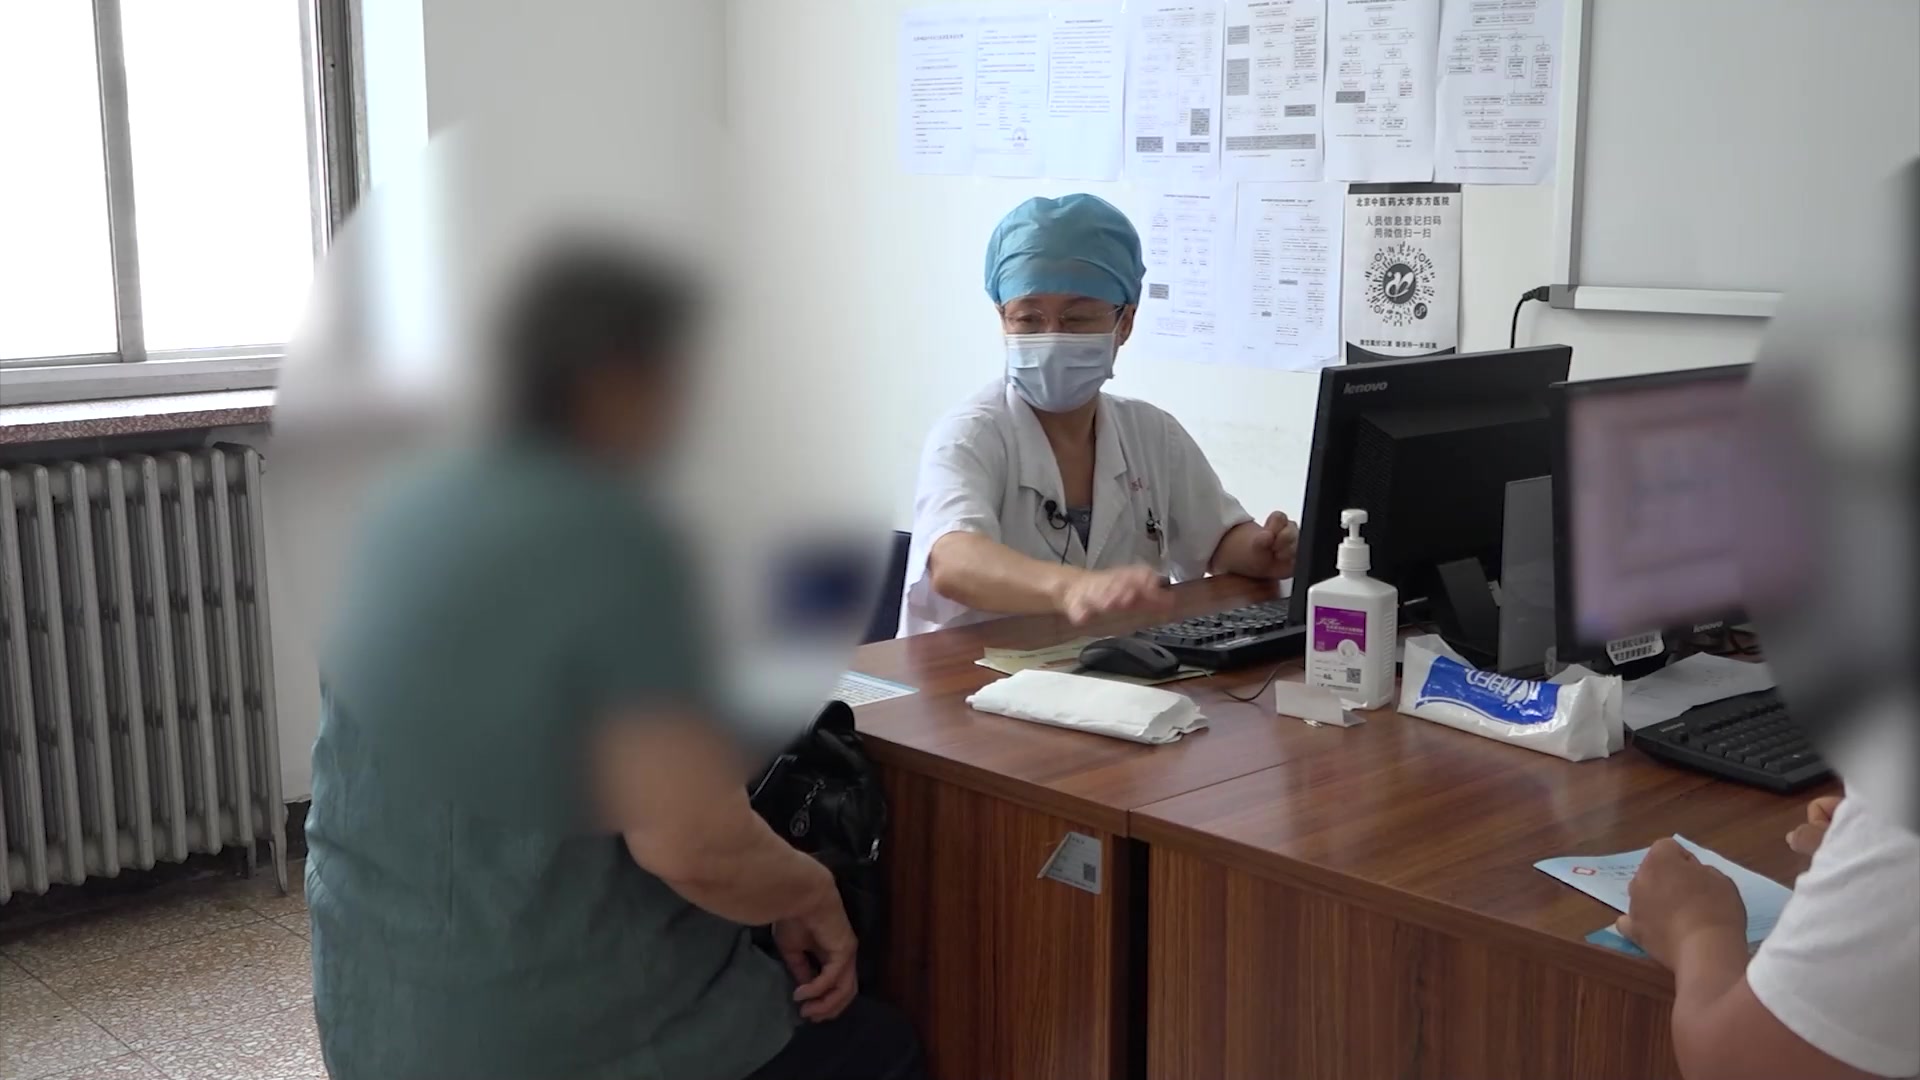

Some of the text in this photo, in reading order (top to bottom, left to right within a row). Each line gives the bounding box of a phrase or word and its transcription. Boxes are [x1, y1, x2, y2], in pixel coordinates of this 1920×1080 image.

[1356, 196, 1450, 207] 北京中医药大学东方医院
[1365, 215, 1442, 226] 人员信息登记扫码
[1374, 228, 1432, 239] 用微信扫一扫
[1343, 381, 1389, 395] lenovo
[1692, 620, 1724, 633] lenovo
